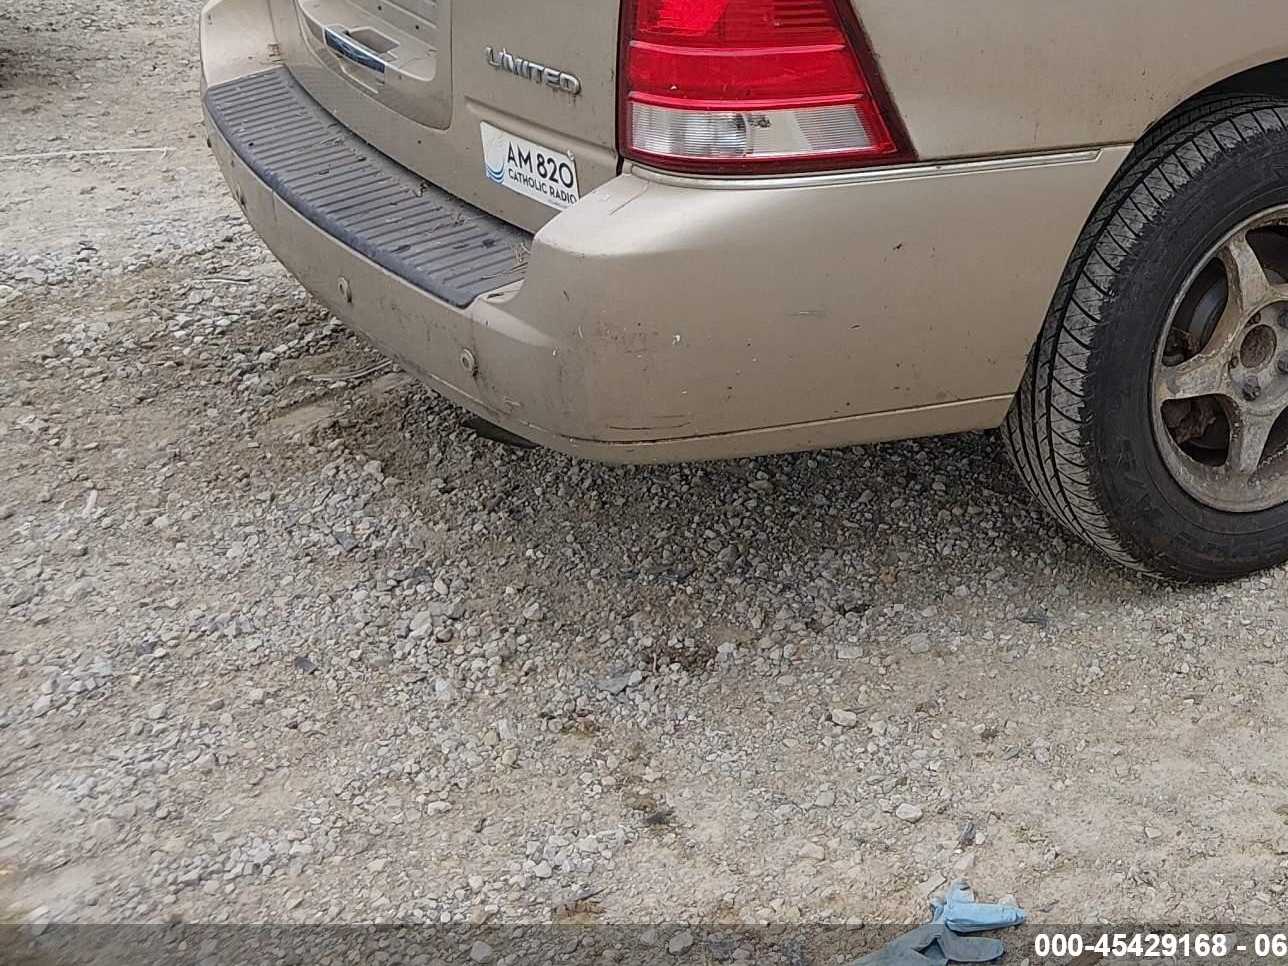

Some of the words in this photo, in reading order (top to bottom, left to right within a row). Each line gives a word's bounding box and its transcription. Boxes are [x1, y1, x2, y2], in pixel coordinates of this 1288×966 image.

[486, 47, 582, 95] LIMITED
[507, 140, 533, 174] AM
[536, 152, 574, 188] 820
[508, 168, 548, 194] CATHOLIC
[549, 185, 578, 204] RADIO
